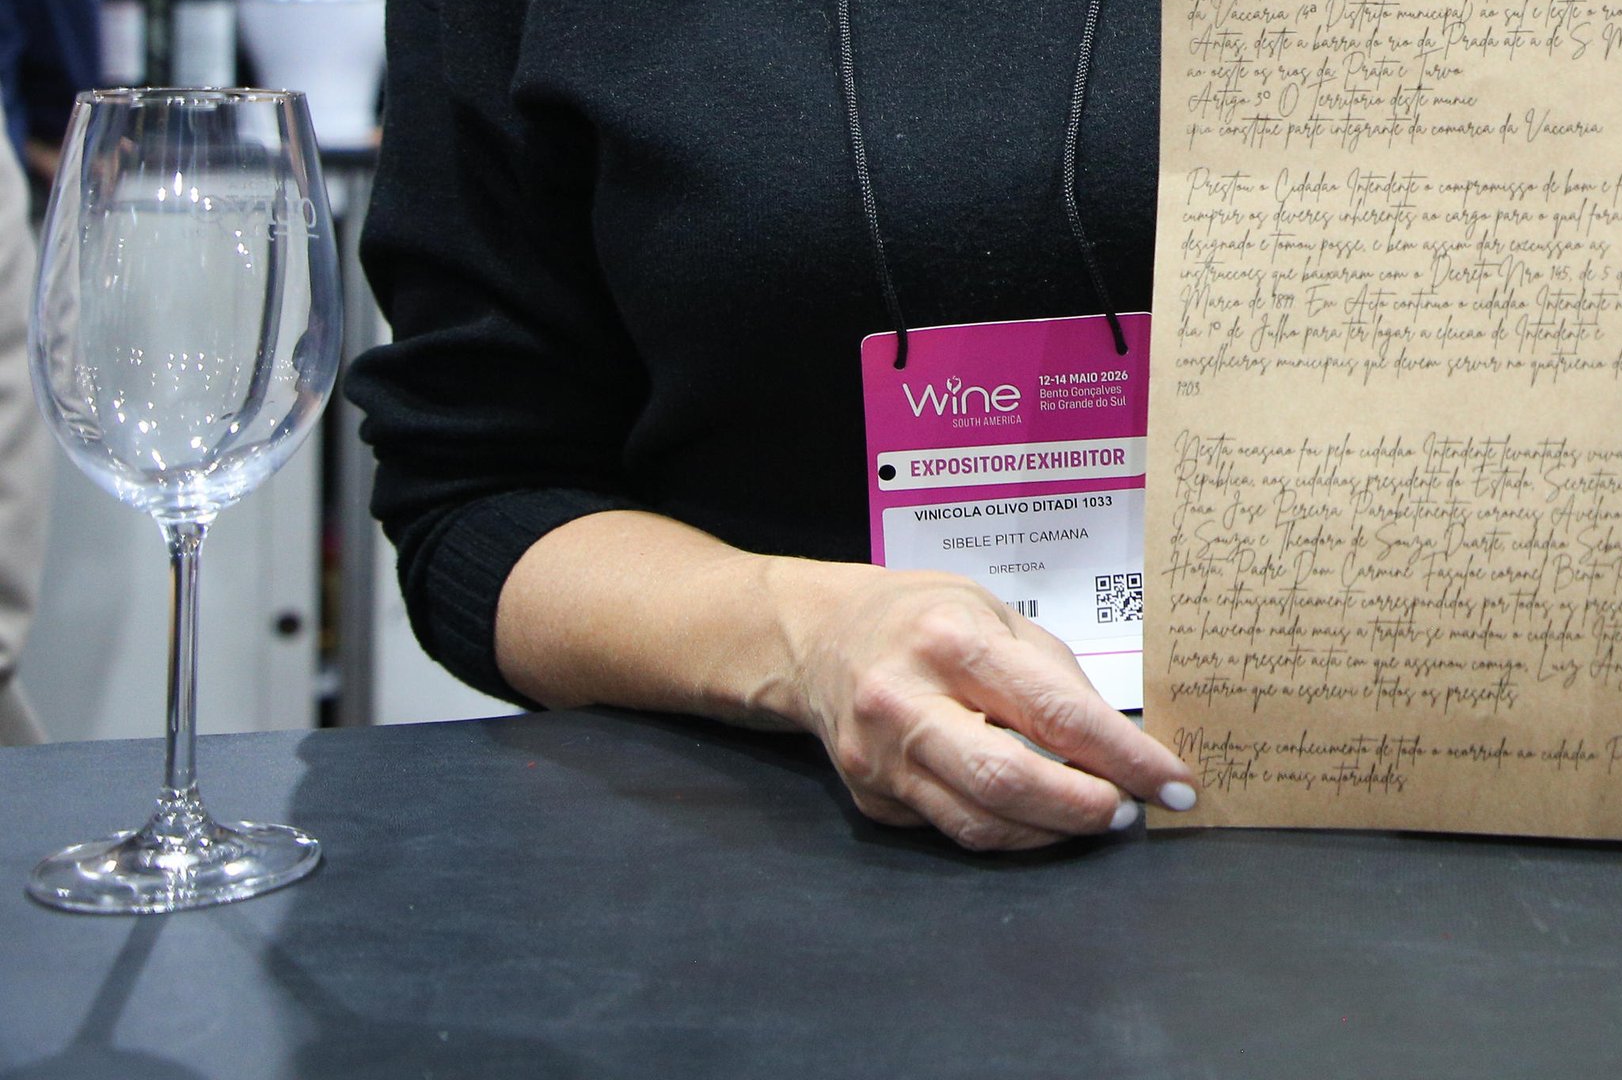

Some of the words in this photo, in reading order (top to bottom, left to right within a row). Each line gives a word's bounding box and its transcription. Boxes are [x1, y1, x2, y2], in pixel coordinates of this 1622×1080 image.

[1039, 374, 1067, 385] 12-14
[1069, 372, 1098, 383] MAIO
[1101, 370, 1129, 382] 2026
[902, 375, 1022, 418] Wine
[1040, 387, 1068, 398] Bento
[1071, 385, 1122, 398] Gonçalves
[1040, 400, 1055, 411] Rio
[1058, 398, 1094, 410] Grande
[1096, 397, 1108, 408] do
[1110, 396, 1127, 407] Sul
[952, 417, 982, 428] SOUTH
[984, 414, 1022, 426] AMERICA
[910, 448, 1126, 477] EXPOSITOR/EXHIBITOR
[914, 506, 981, 521] VINICOLA
[985, 502, 1028, 516] OLIVO
[1032, 499, 1078, 512] DITADI
[1082, 496, 1113, 508] 1033
[942, 536, 991, 550] SIBELE
[995, 532, 1025, 547] PITT
[1029, 528, 1089, 543] CAMANA
[989, 562, 1045, 575] DIRETORA
